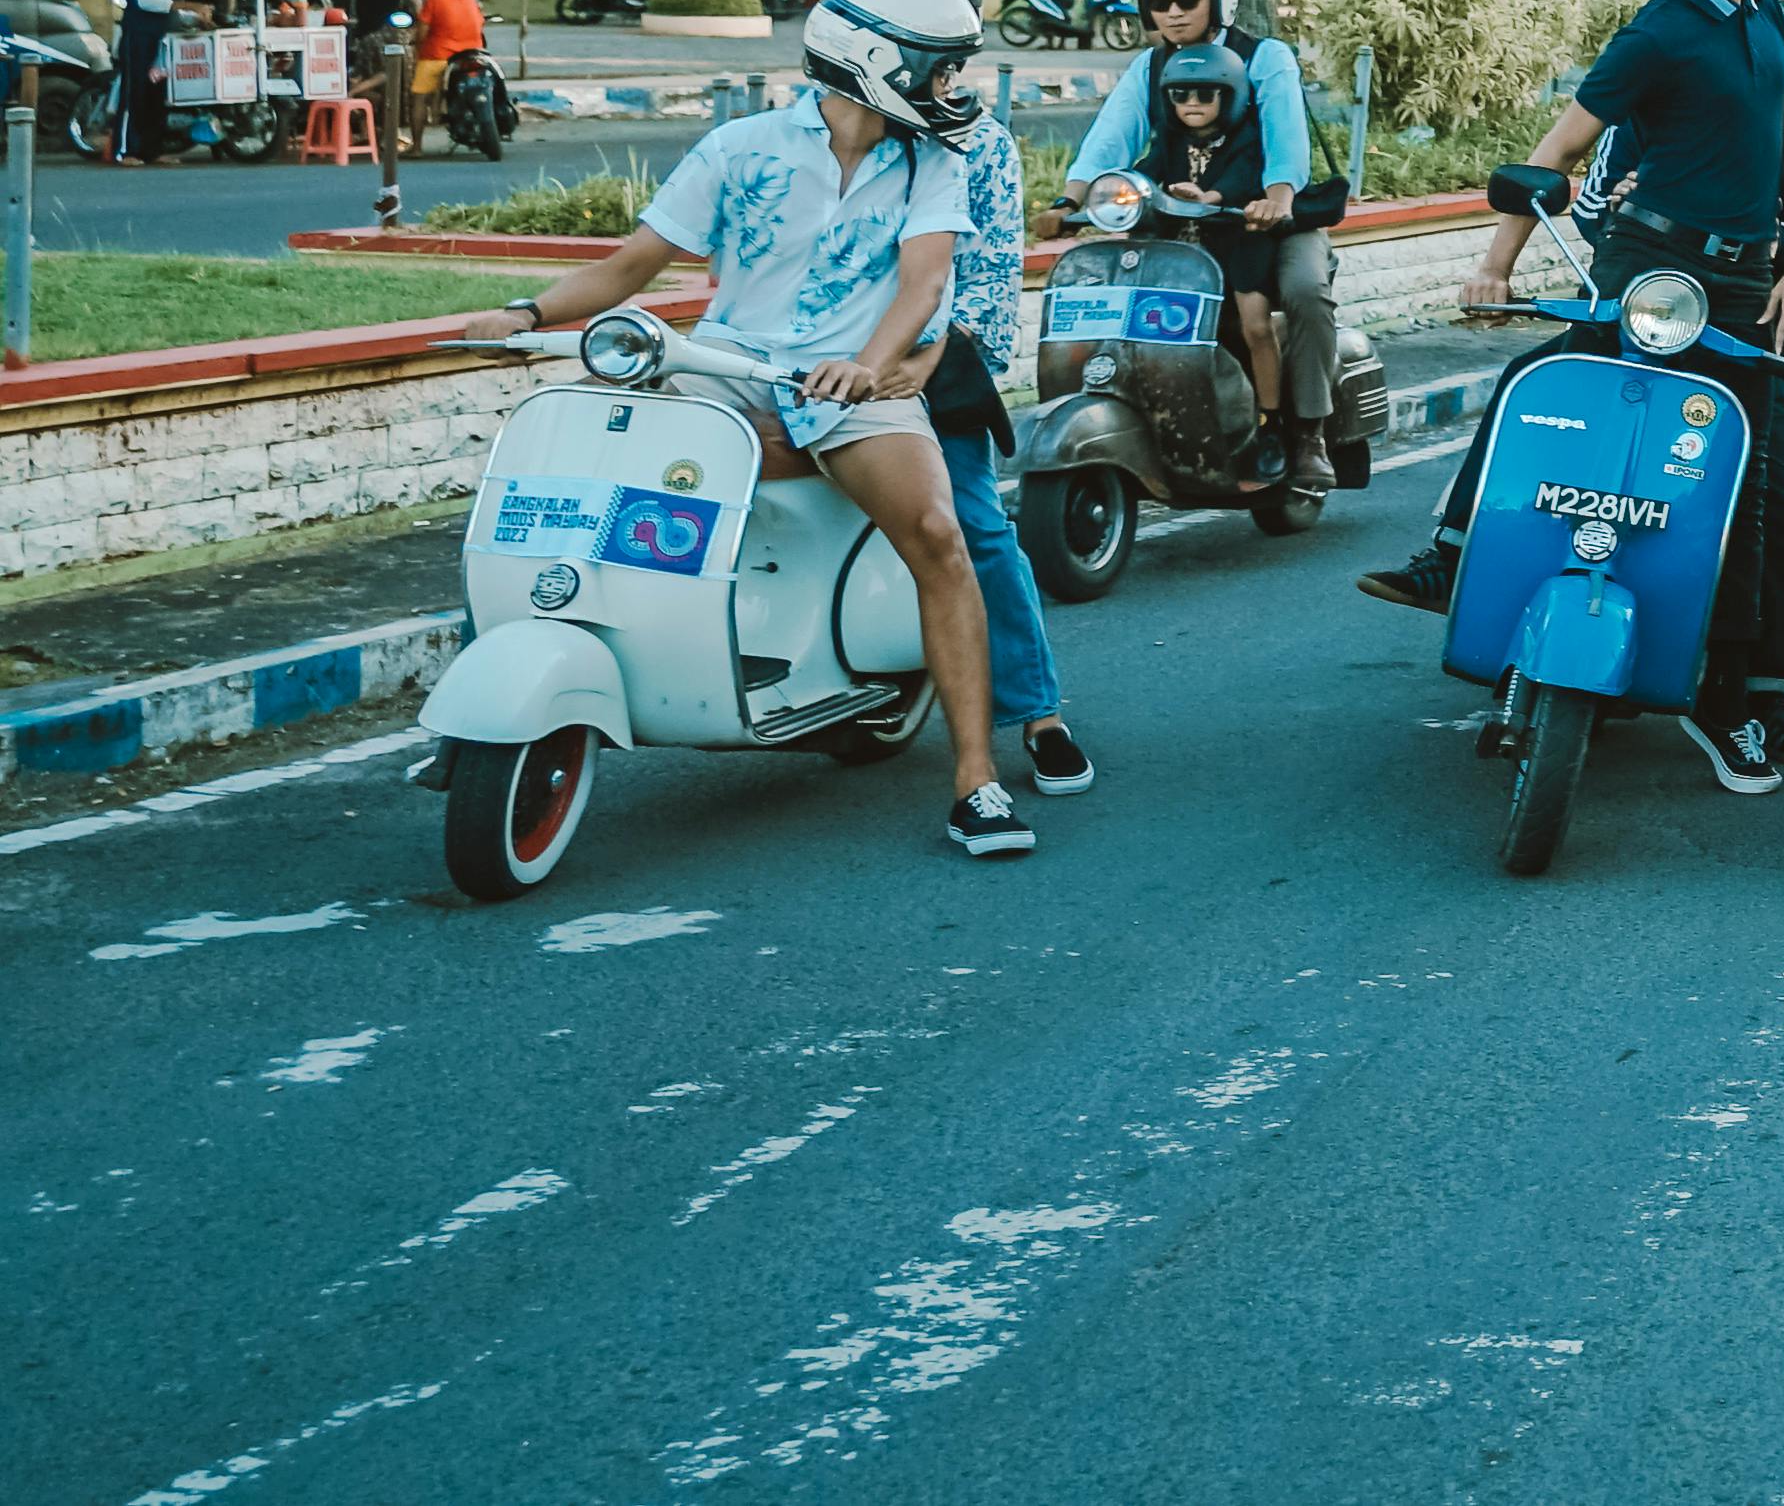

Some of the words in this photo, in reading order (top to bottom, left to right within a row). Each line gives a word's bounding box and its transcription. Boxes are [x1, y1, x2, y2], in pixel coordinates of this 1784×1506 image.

[1520, 414, 1588, 430] vespa
[501, 494, 581, 514] BANGKALAN
[1535, 482, 1670, 529] M2281VH
[498, 511, 538, 528] MODS
[541, 512, 601, 531] MAYDAY
[494, 526, 529, 543] 2023
